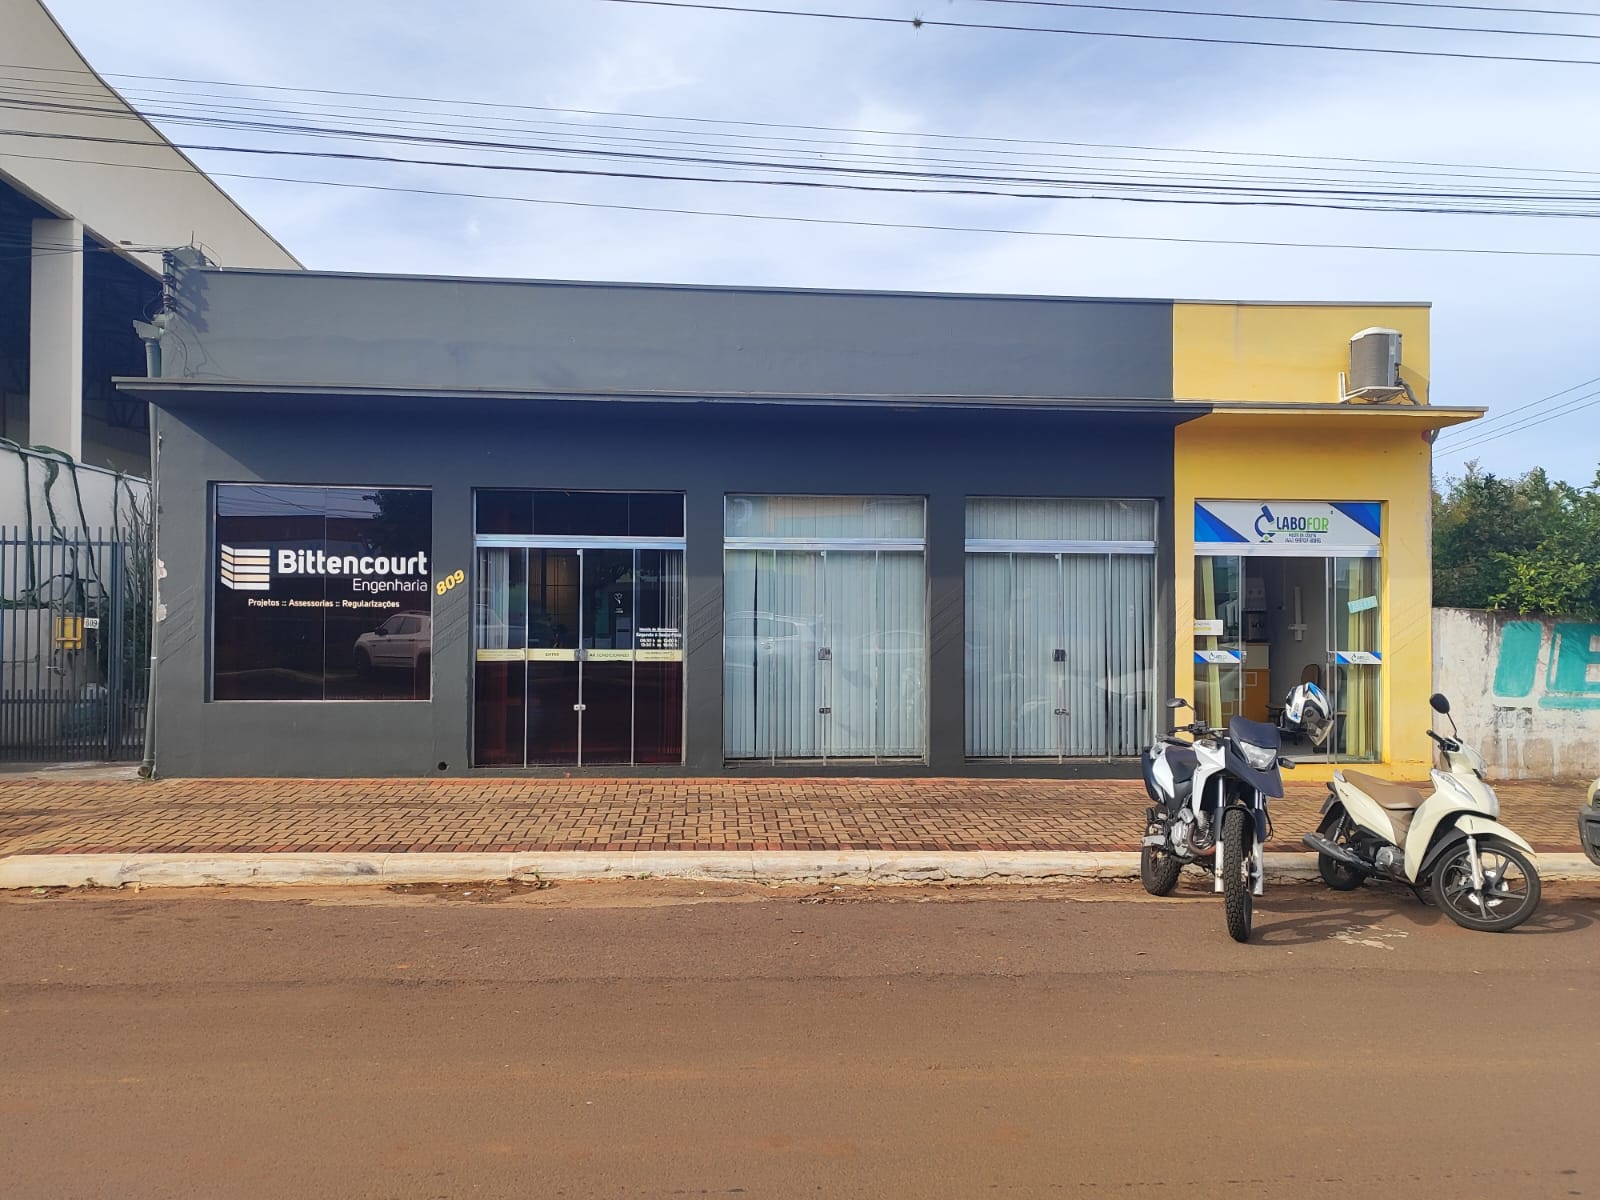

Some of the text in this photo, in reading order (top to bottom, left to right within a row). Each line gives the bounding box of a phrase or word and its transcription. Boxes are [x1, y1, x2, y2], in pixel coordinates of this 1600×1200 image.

[1276, 516, 1329, 531] LABOFOR
[278, 549, 428, 575] Bittencourt
[353, 578, 428, 594] Engenharia
[436, 569, 465, 596] 809
[248, 598, 280, 608] Projetos
[289, 599, 334, 608] Assessorias
[342, 600, 400, 609] Regularizações
